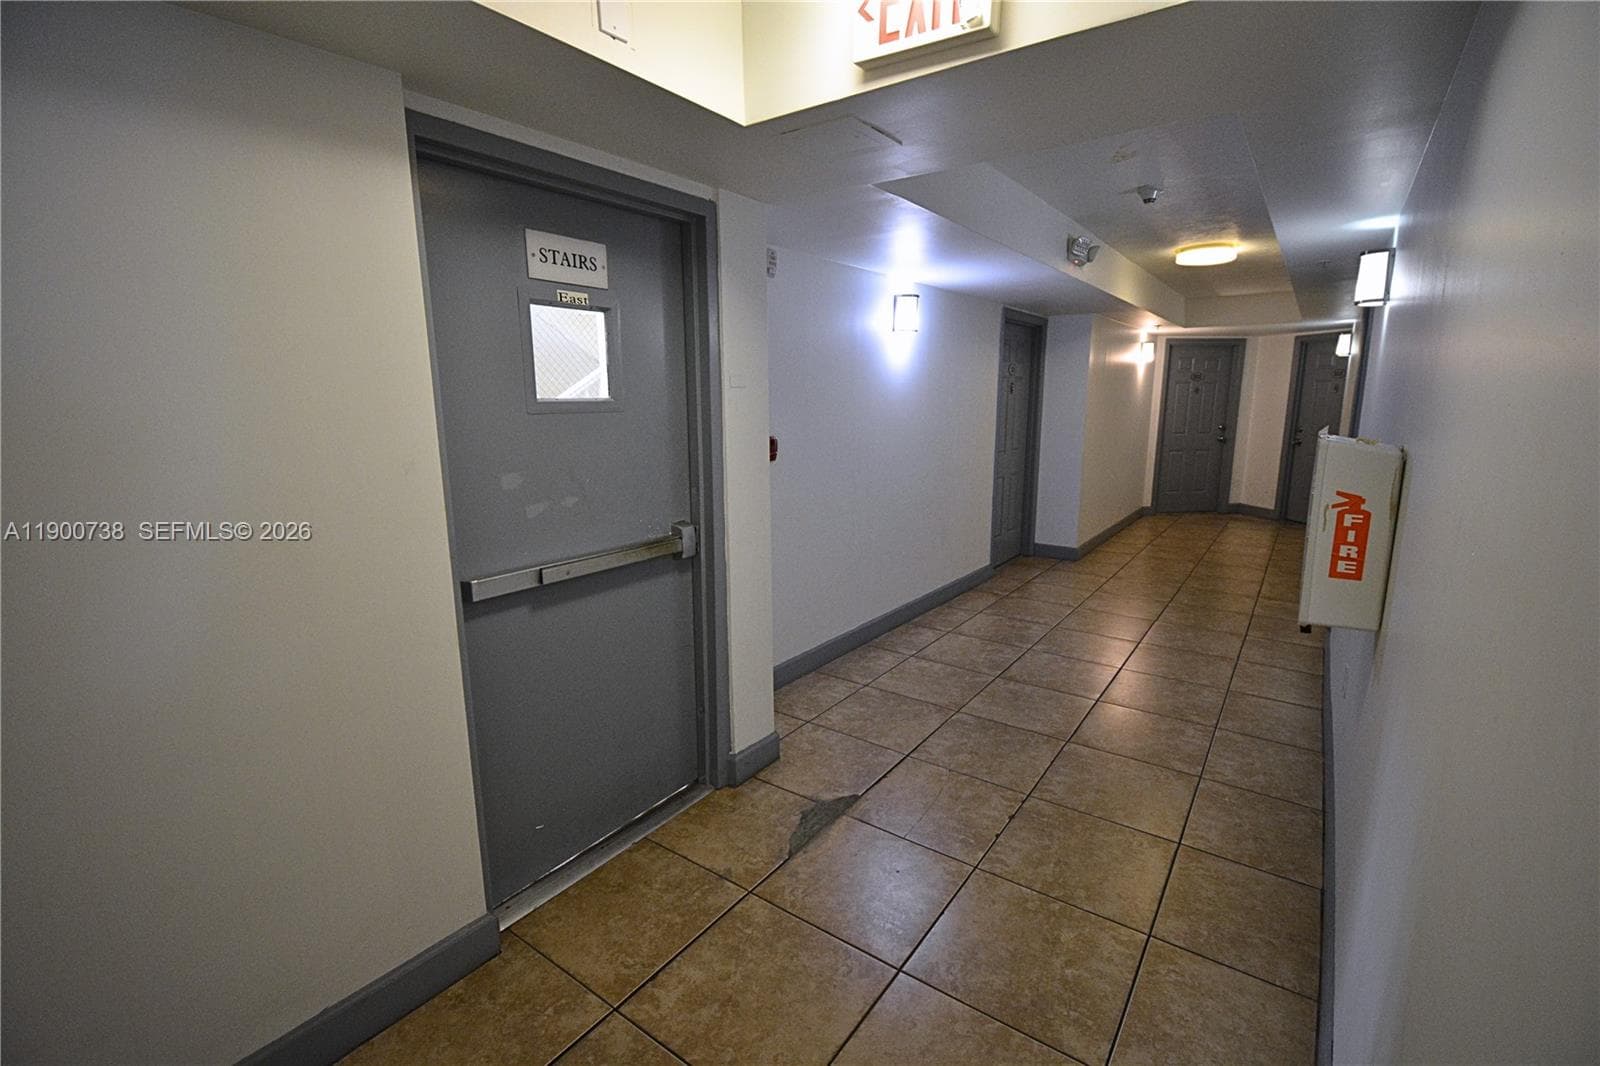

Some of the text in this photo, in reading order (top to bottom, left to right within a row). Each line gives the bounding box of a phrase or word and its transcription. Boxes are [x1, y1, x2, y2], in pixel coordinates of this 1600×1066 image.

[539, 247, 598, 272] STAIRS
[558, 291, 588, 305] East
[1336, 513, 1364, 574] FIRE
